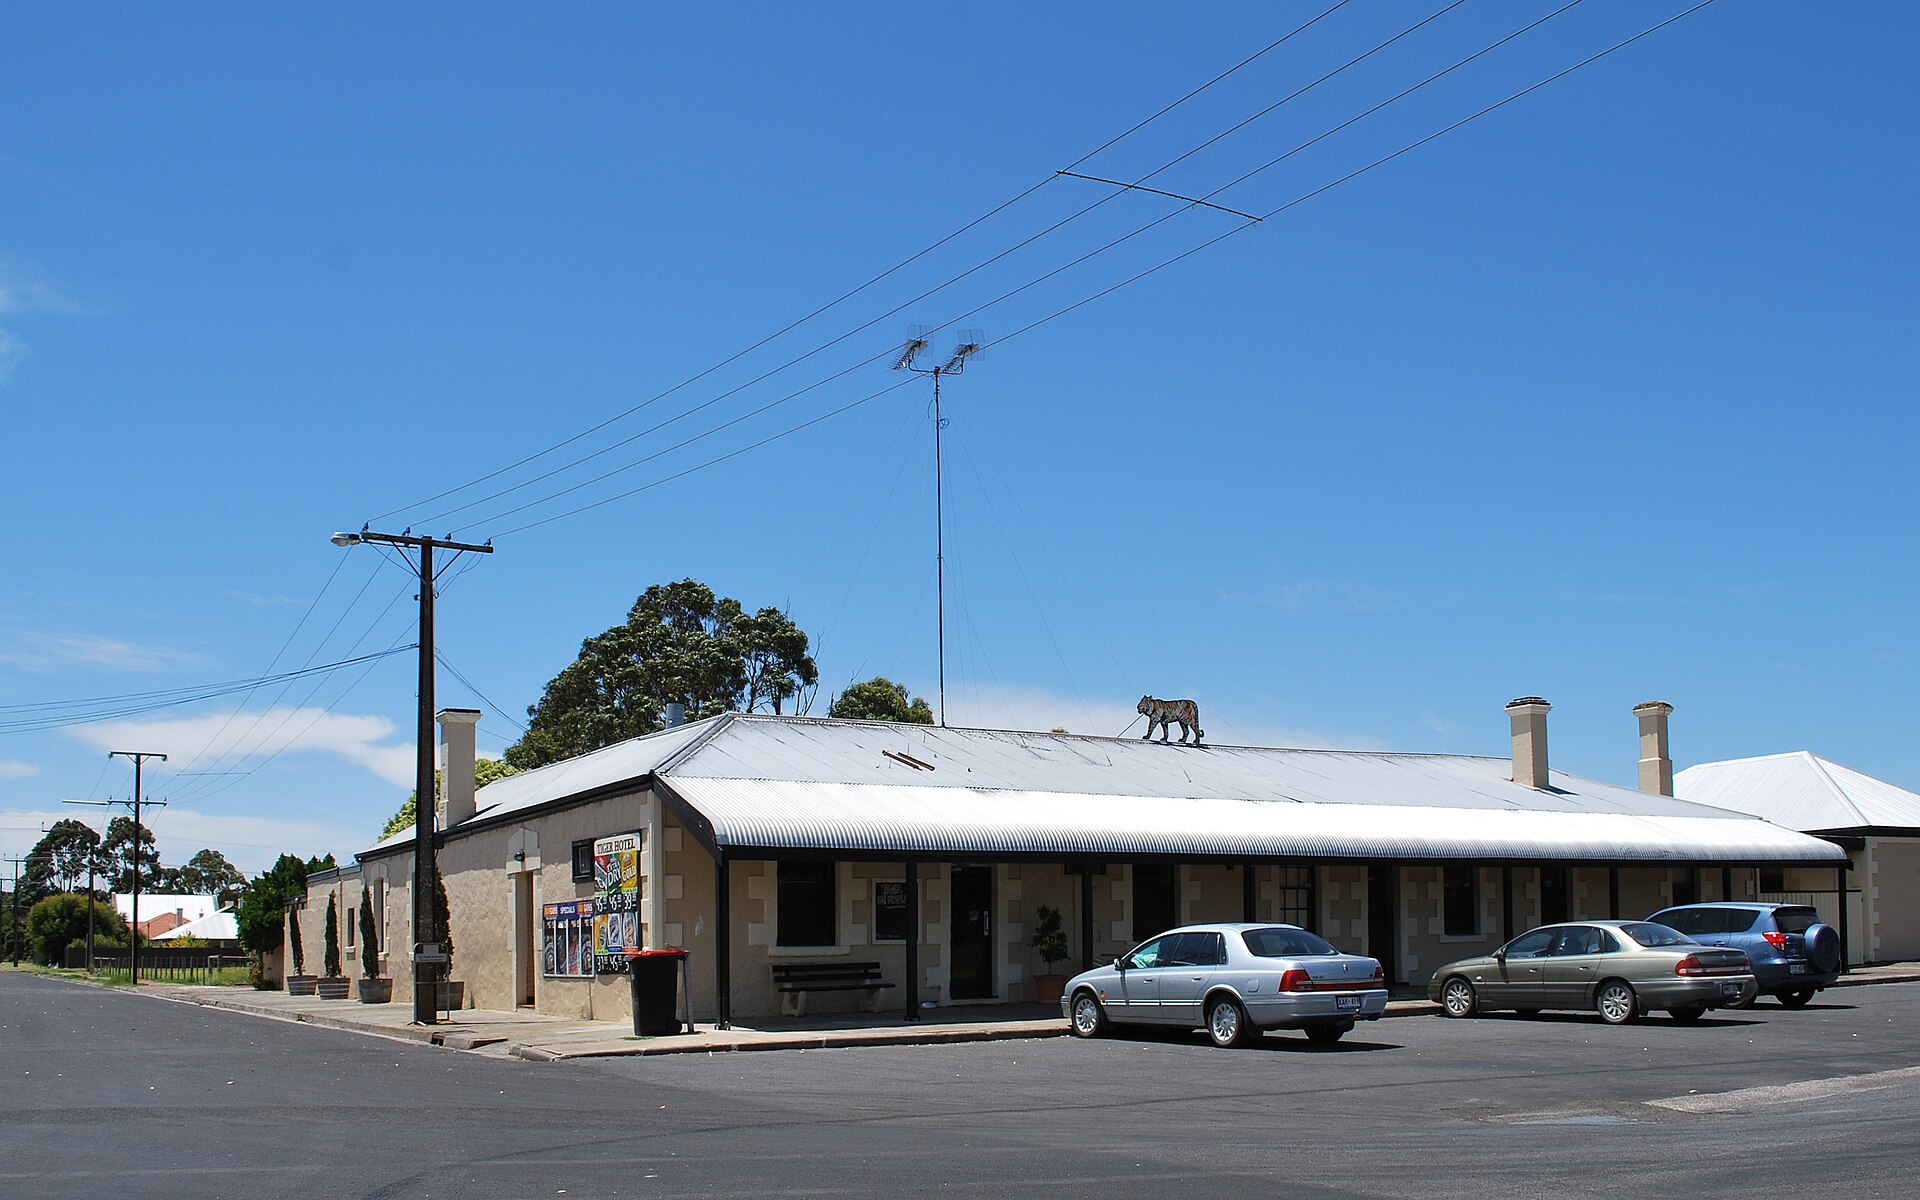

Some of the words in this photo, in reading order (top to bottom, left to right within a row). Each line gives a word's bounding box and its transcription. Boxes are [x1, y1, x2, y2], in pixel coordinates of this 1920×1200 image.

[597, 841, 613, 854] TIGER
[614, 838, 635, 851] HOTEL
[608, 867, 621, 887] DRY
[622, 865, 637, 882] GOLD
